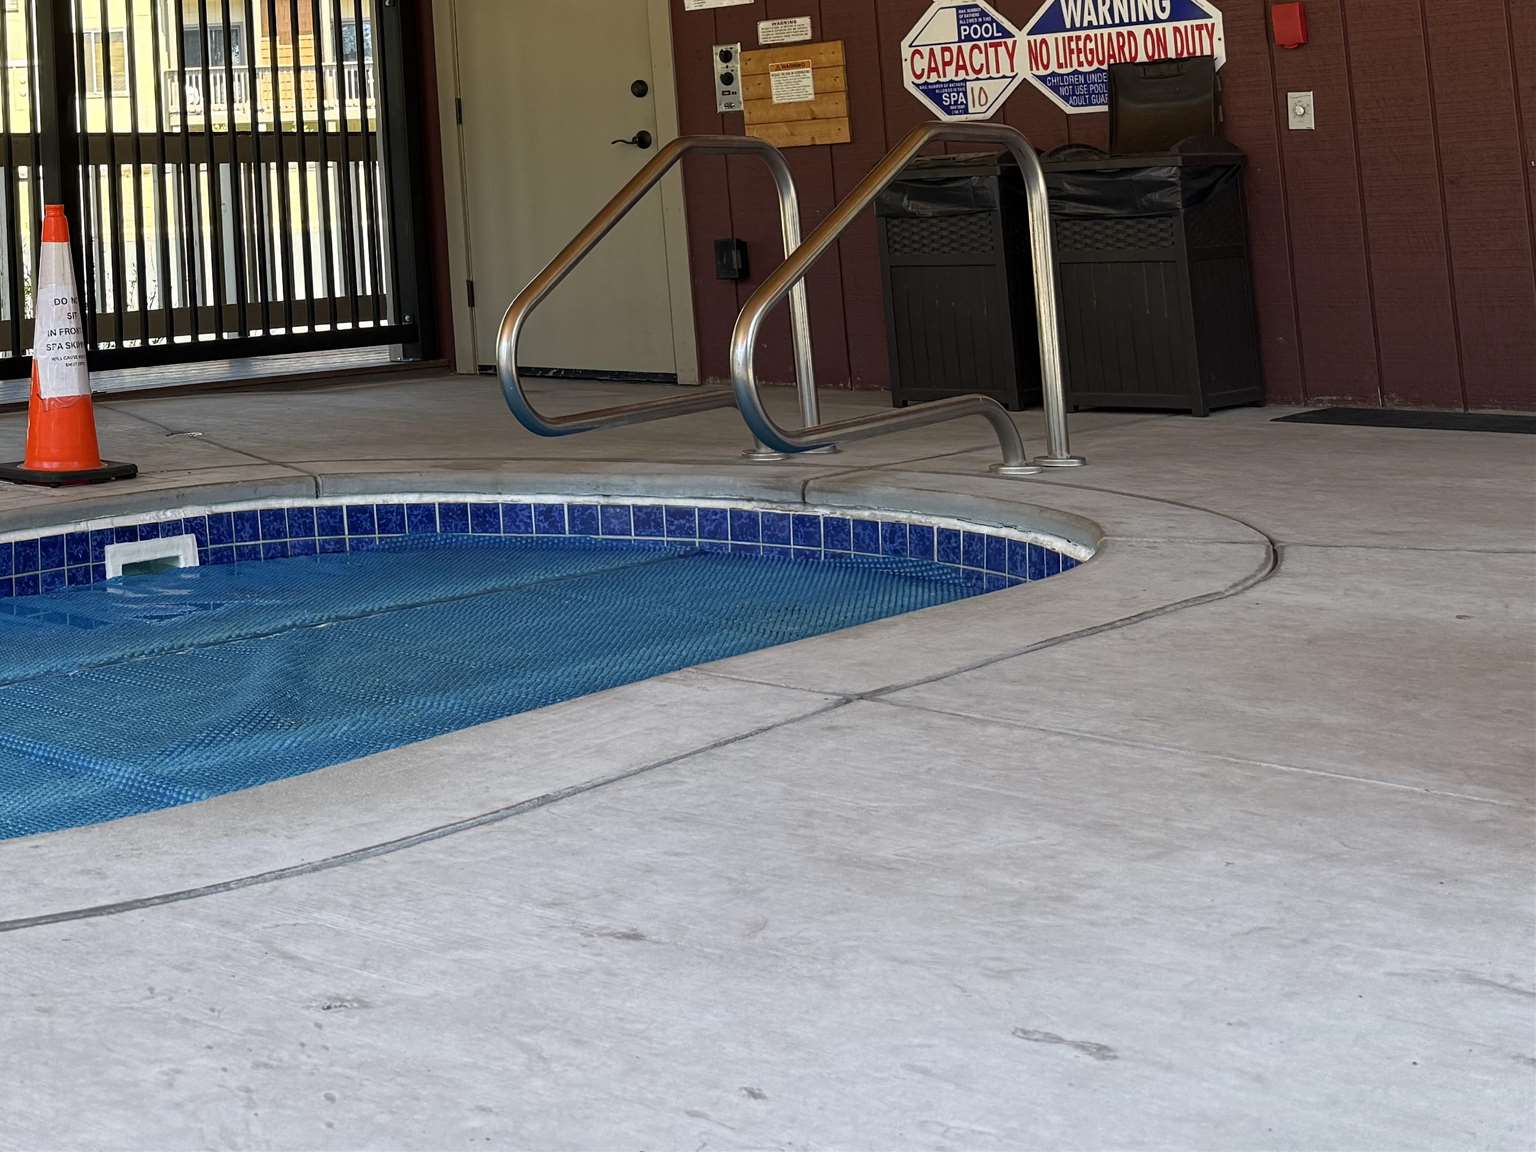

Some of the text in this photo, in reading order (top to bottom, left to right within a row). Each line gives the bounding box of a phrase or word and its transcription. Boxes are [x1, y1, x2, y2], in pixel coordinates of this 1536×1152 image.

[961, 23, 1002, 39] POOL
[1027, 22, 1215, 72] NO LIFEGUARD ON DUTY
[911, 40, 1017, 80] CAPACITY
[1047, 73, 1085, 86] CHILDREN
[1059, 82, 1108, 95] NOT USE POOL
[942, 92, 966, 105] SPA
[971, 87, 988, 108] 10
[1068, 95, 1090, 105] ADULT
[48, 329, 56, 337] IN
[46, 343, 63, 351] SPA
